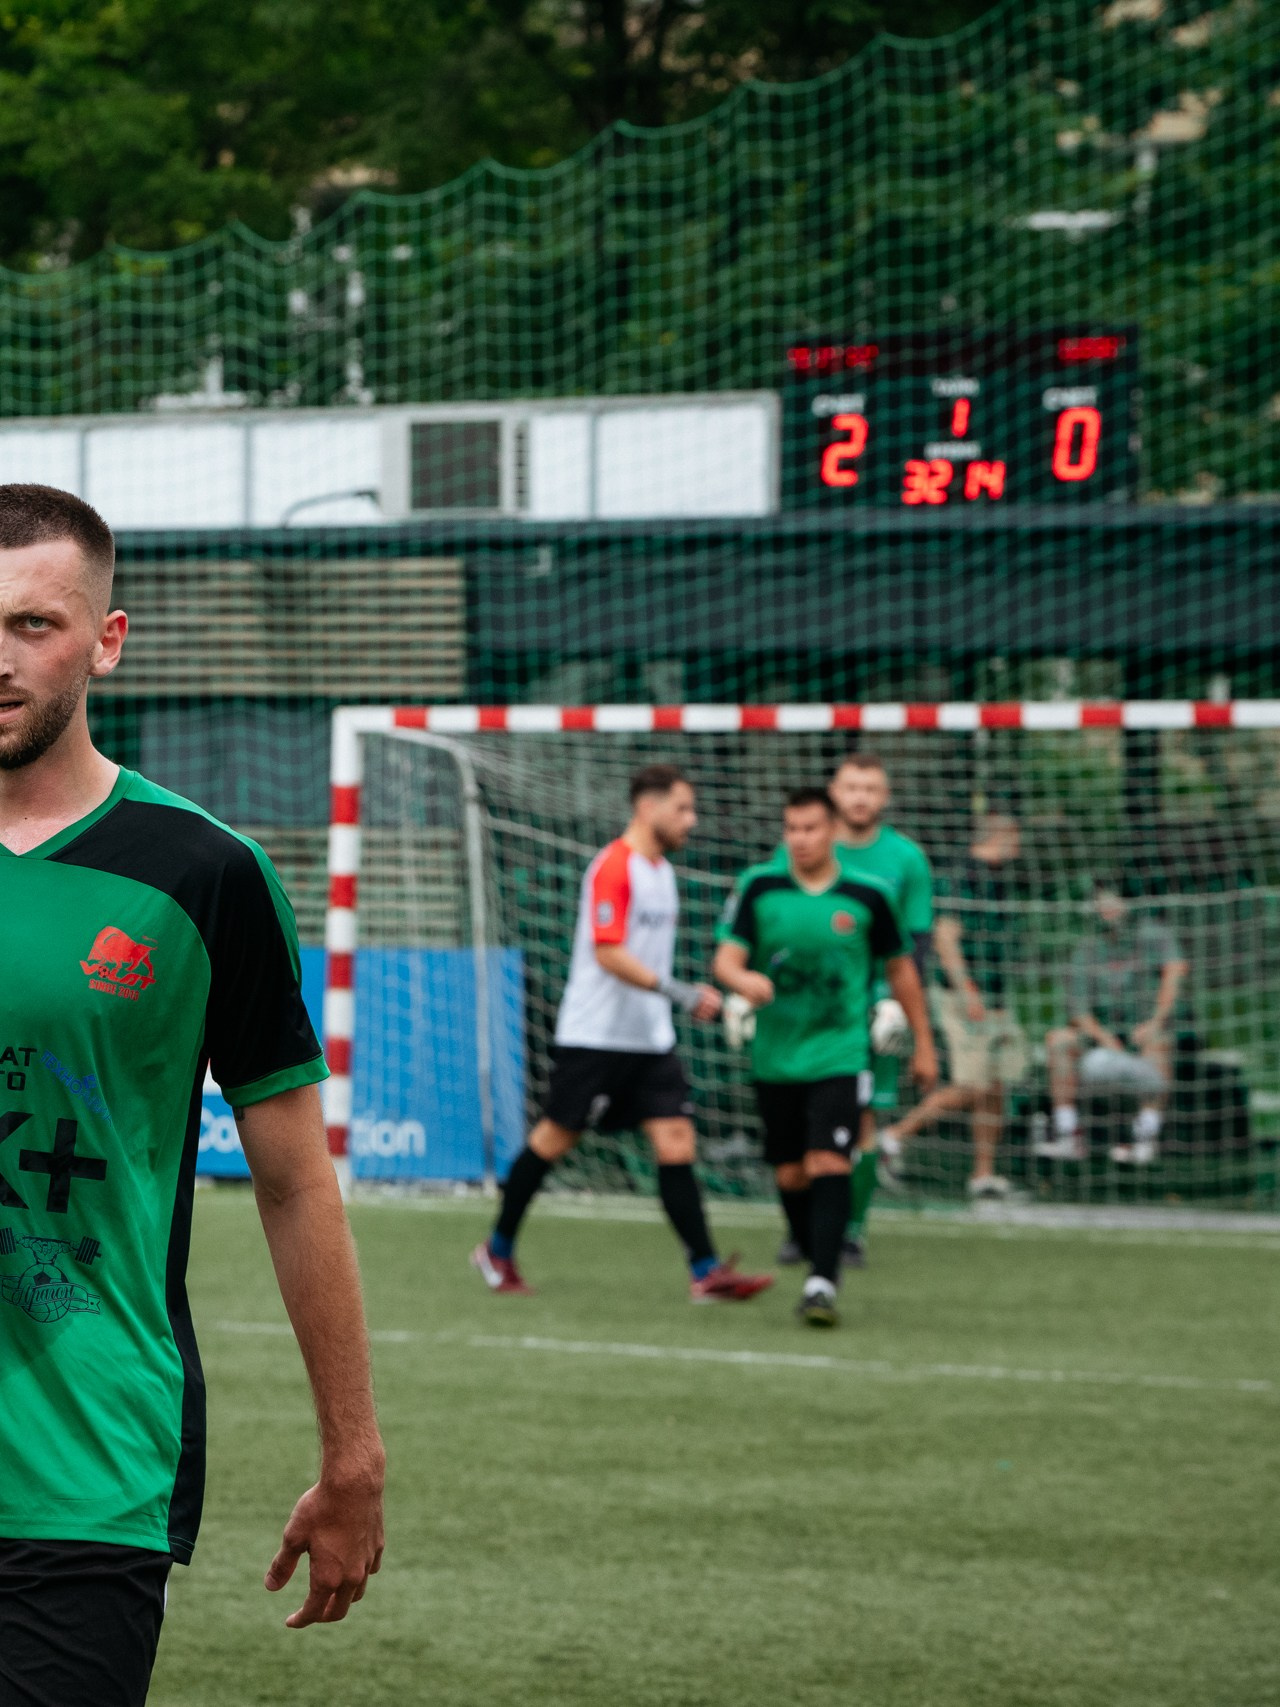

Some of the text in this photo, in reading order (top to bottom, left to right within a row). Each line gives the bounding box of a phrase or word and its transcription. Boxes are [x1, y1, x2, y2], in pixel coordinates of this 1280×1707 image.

[951, 398, 970, 438] 1
[821, 414, 868, 487] 2
[1052, 407, 1101, 482] 0
[901, 459, 1006, 505] 32 14
[88, 979, 118, 995] SINCE
